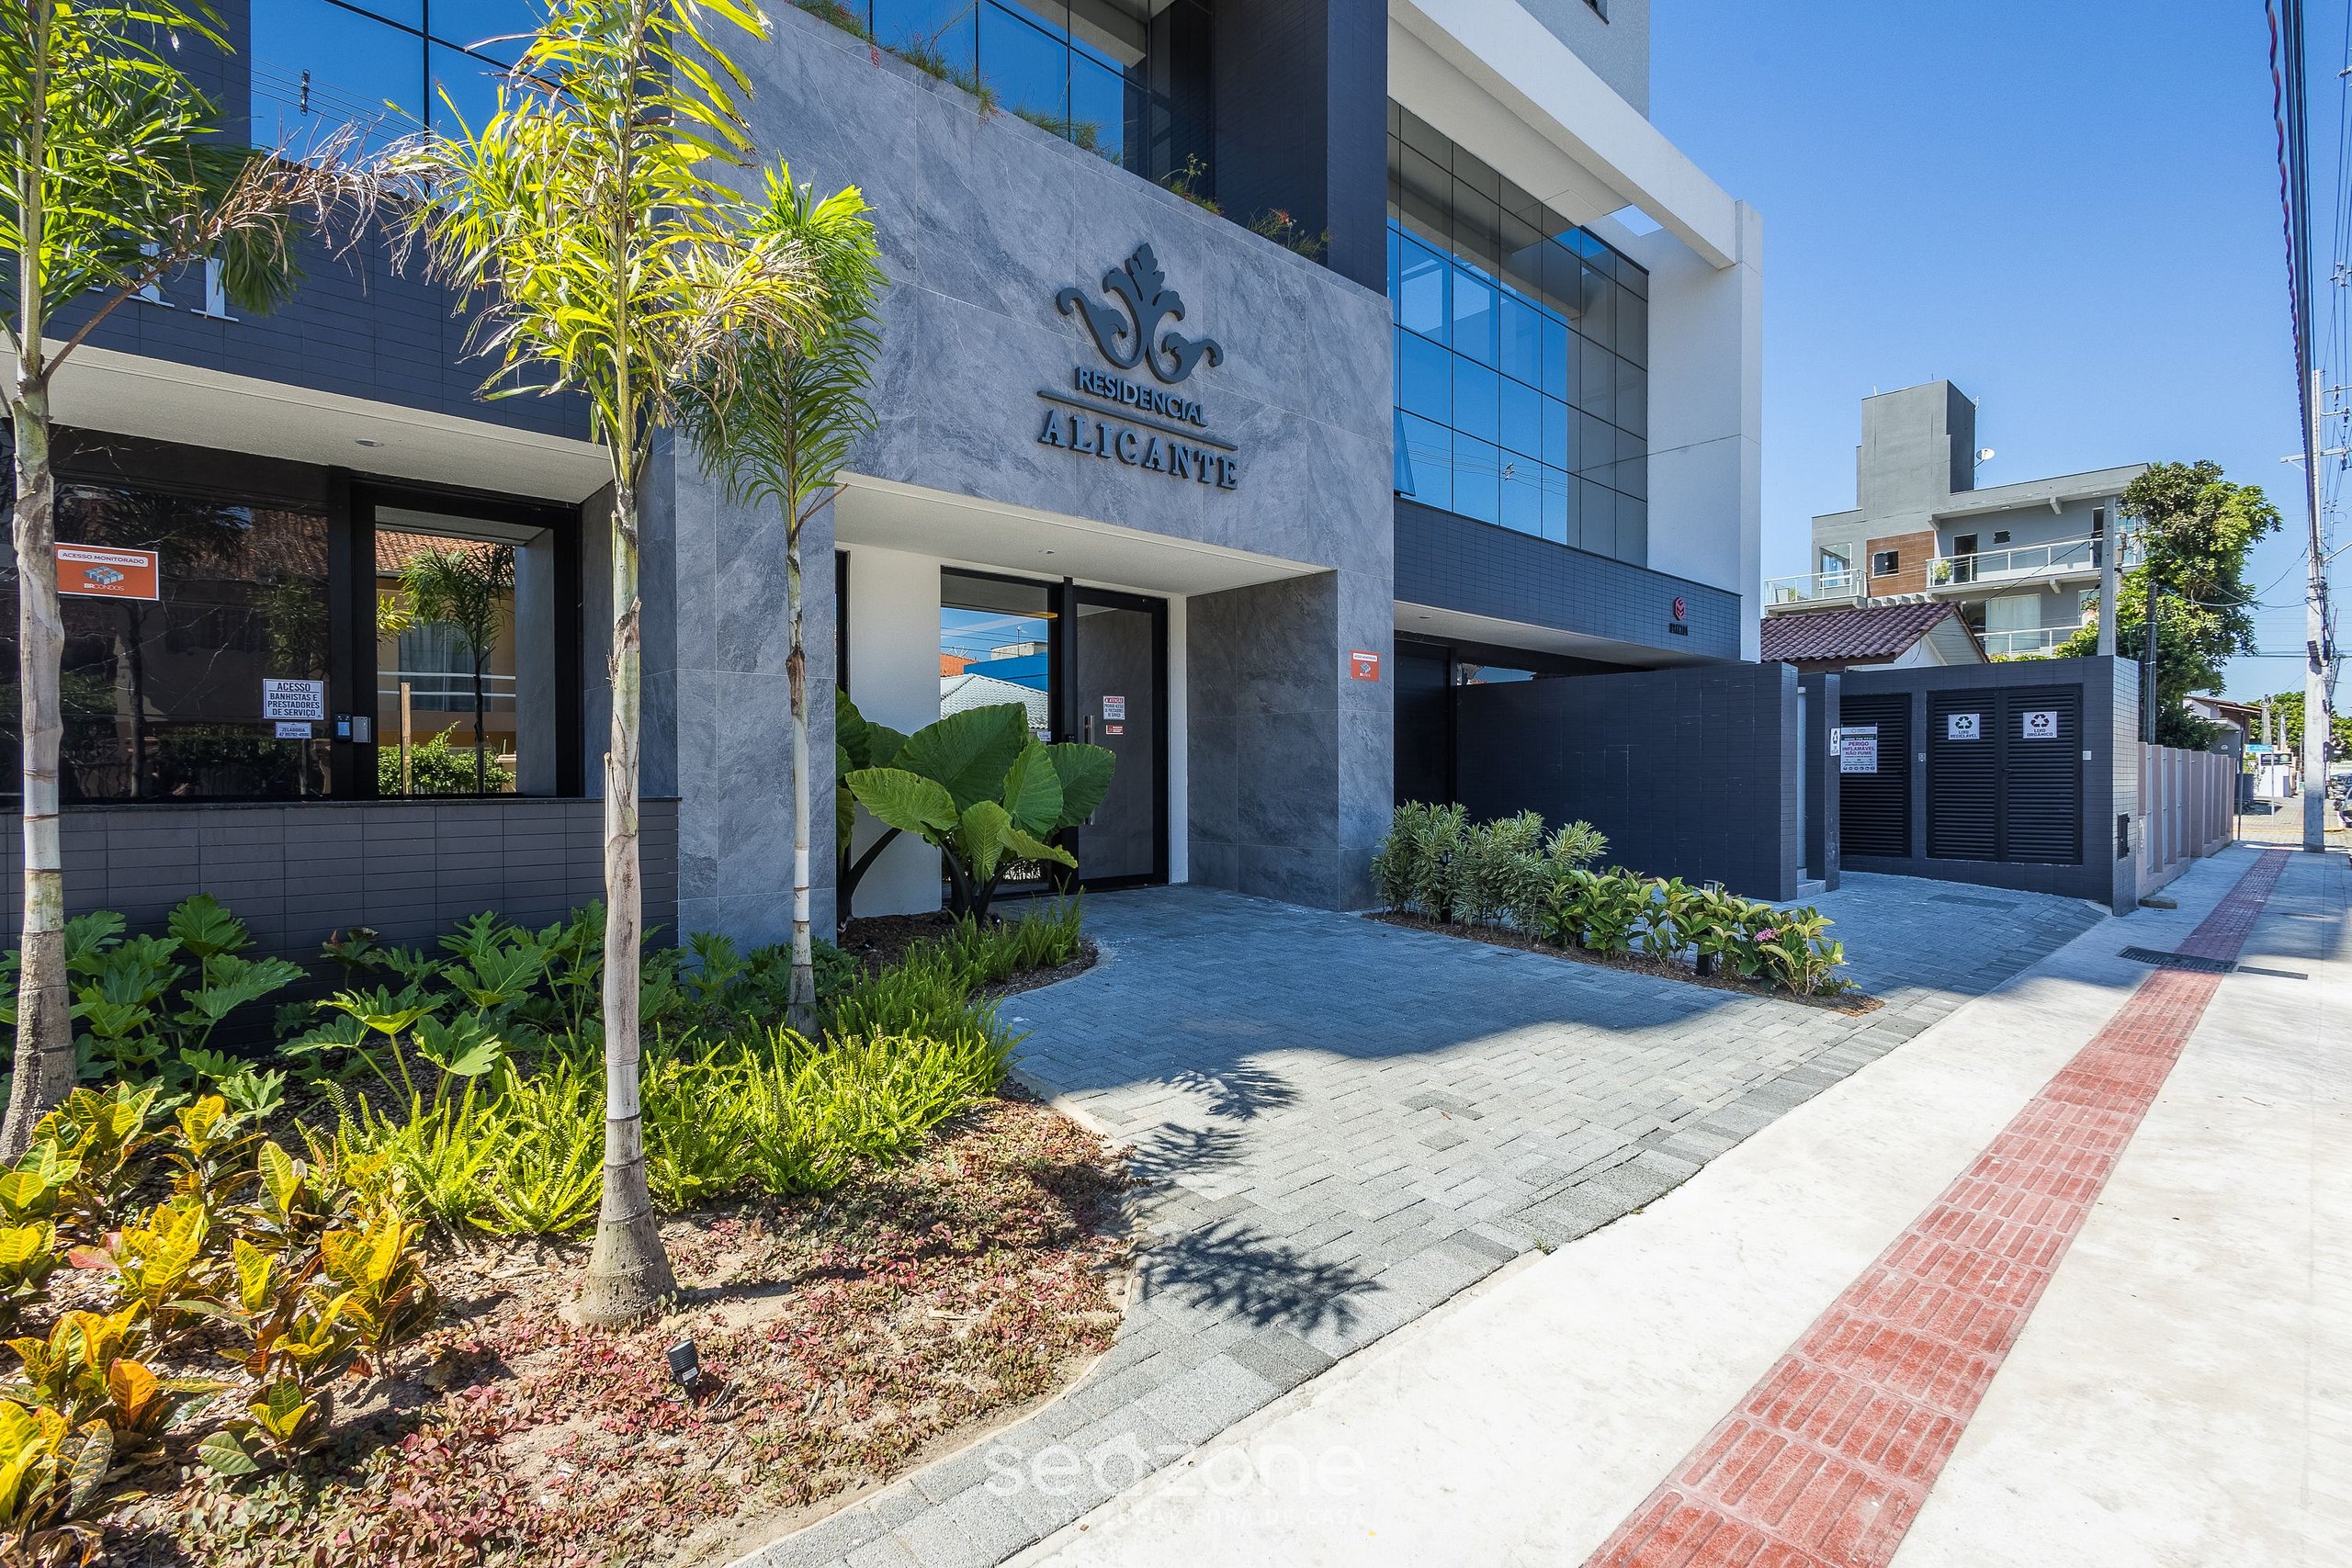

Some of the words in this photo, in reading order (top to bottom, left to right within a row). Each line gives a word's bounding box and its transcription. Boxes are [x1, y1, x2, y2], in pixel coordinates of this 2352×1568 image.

[1075, 367, 1208, 427] RESIDENCIAL
[1037, 410, 1238, 490] ALICANTE
[94, 555, 145, 565] MONITORADO
[277, 682, 311, 692] ACESSO
[270, 693, 311, 701] BANHISTAS
[267, 701, 320, 709] PRESTADORES
